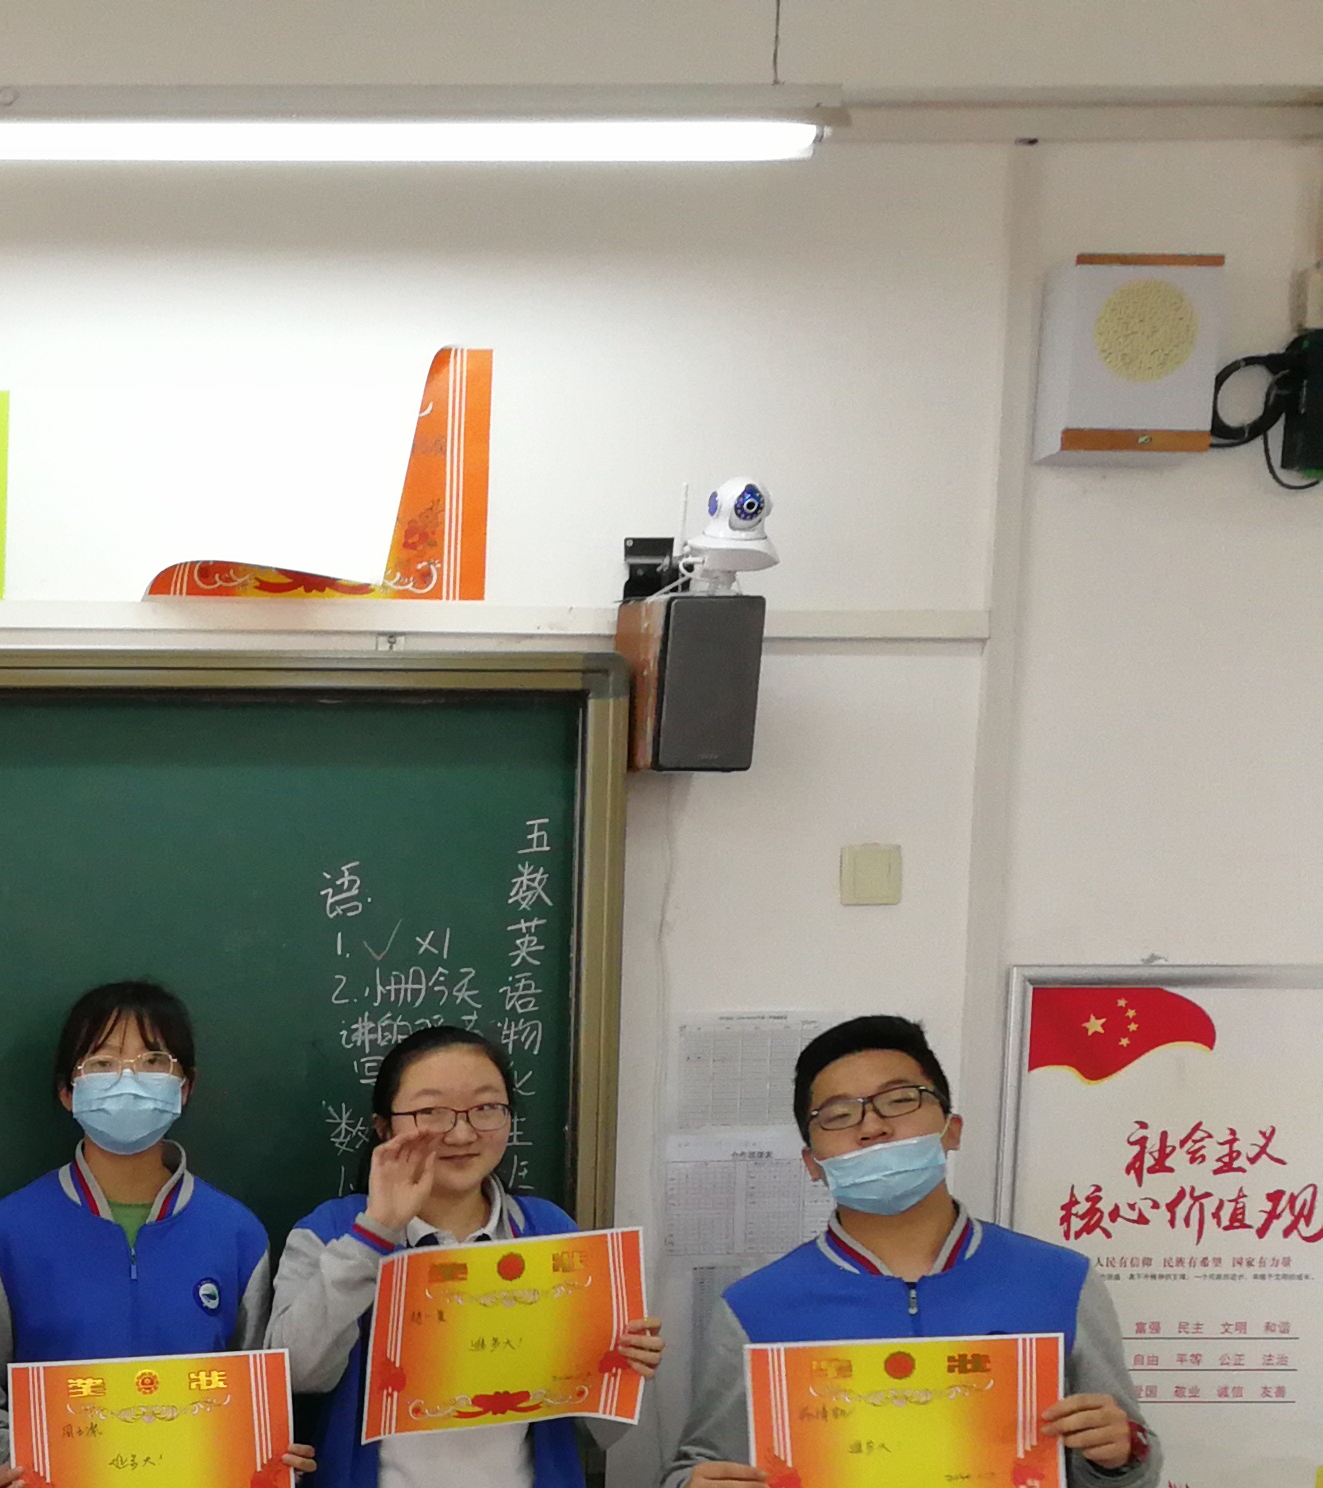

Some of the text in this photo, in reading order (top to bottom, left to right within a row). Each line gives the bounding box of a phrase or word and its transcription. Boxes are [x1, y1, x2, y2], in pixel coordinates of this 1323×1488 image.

[1124, 1121, 1287, 1187] 社会主义
[1059, 1183, 1323, 1246] 核心价值观
[1163, 1256, 1222, 1268] 民族有希望
[1178, 1321, 1204, 1334] 民主
[1220, 1321, 1248, 1334] 文明
[1133, 1353, 1289, 1367] 自由 平等 公正 法治
